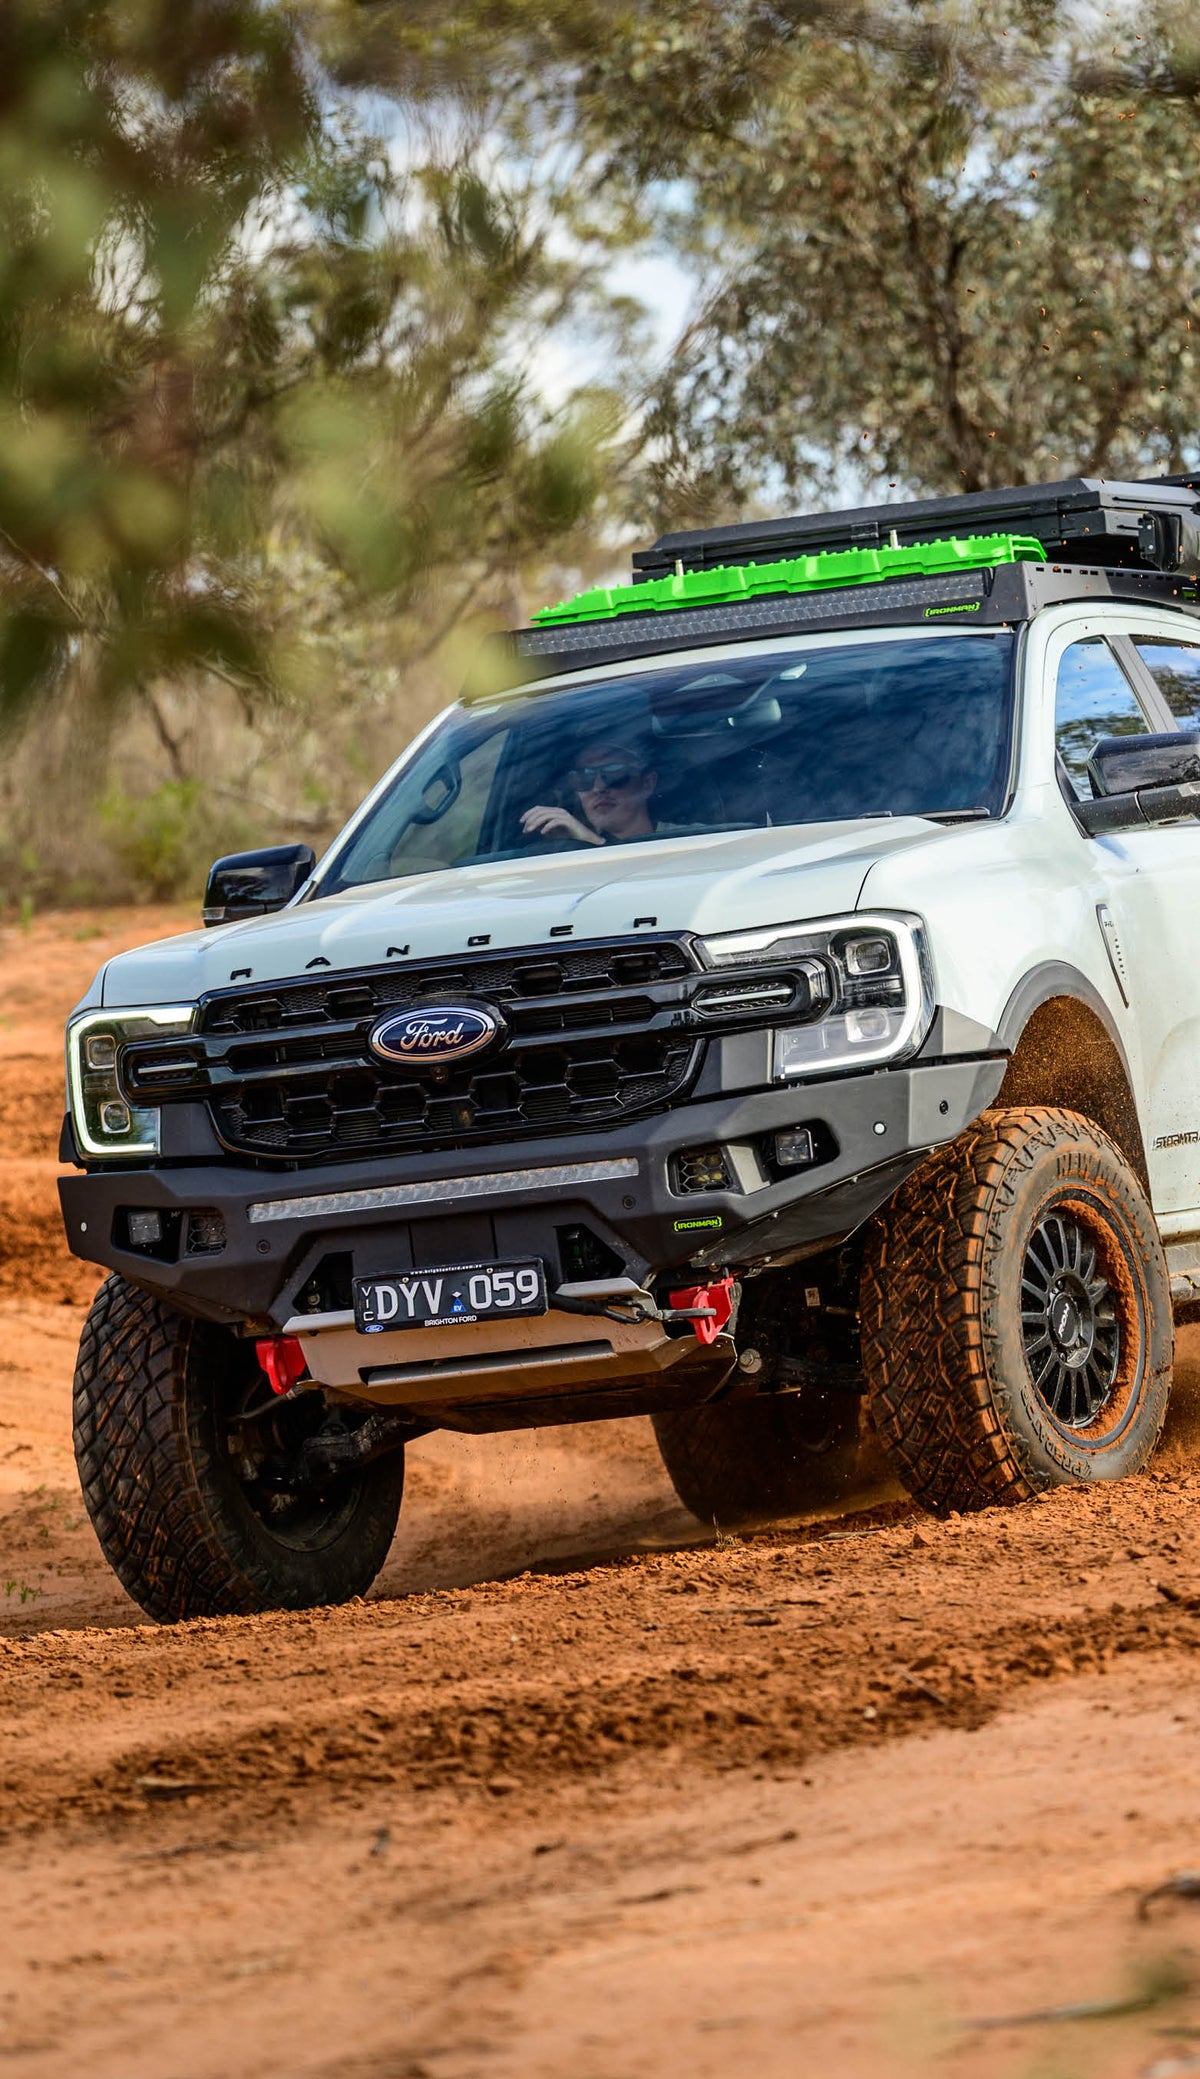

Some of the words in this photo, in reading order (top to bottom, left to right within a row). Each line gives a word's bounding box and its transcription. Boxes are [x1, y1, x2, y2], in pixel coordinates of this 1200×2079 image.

[929, 603, 976, 616] IRONMAN
[230, 916, 658, 981] RANGER
[400, 1018, 464, 1051] Ford
[1156, 1131, 1200, 1149] STORMTR
[677, 1219, 719, 1230] IRONMAN
[361, 1286, 374, 1321] VIC
[375, 1279, 444, 1321] DYV
[469, 1269, 539, 1310] 059
[424, 1317, 458, 1327] BRIGHTON
[458, 1315, 477, 1323] FORD
